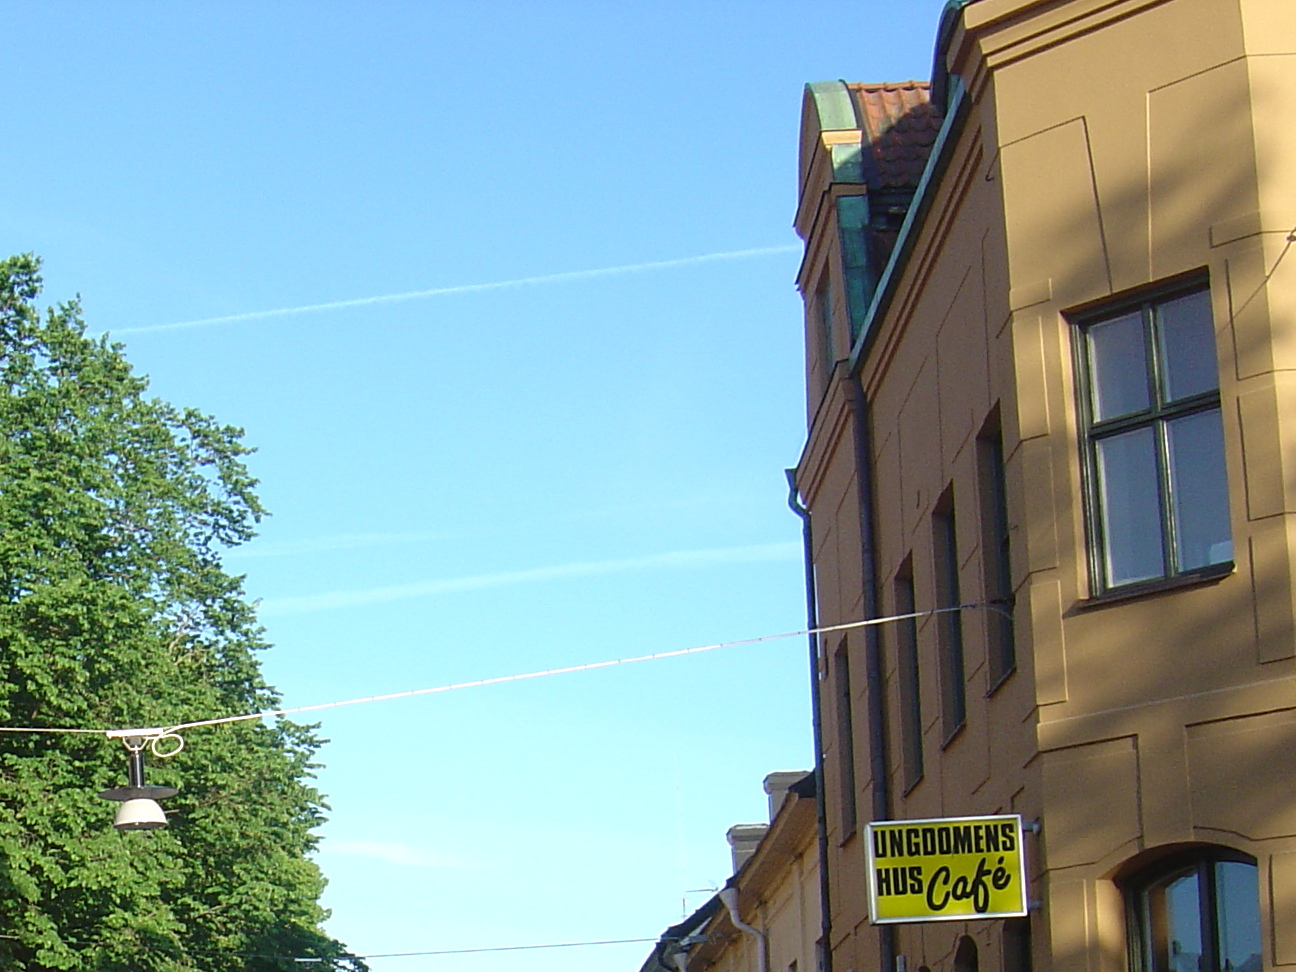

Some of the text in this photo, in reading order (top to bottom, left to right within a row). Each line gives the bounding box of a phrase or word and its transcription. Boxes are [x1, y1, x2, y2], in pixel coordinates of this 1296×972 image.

[873, 823, 1016, 858] UNGDOMENS
[876, 855, 1012, 914] HUS Café
